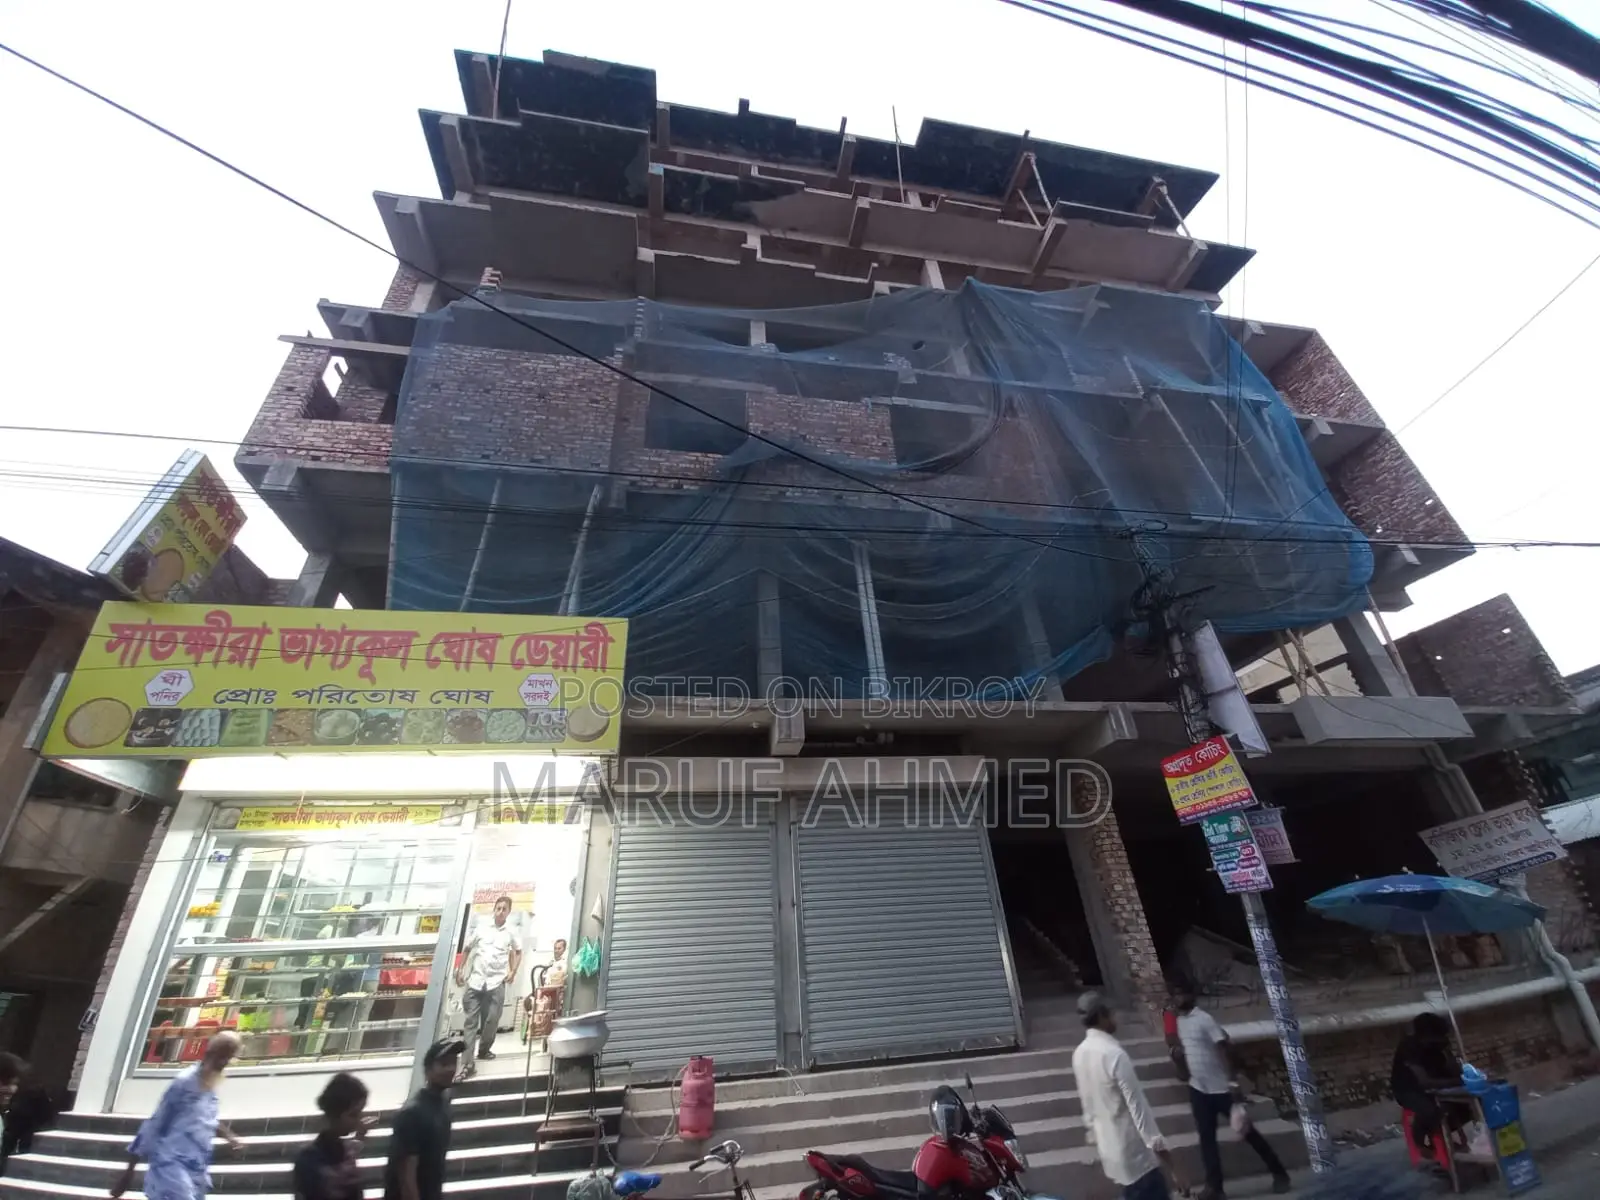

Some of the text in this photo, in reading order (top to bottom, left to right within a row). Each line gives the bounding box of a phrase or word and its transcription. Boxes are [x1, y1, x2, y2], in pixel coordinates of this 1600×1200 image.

[105, 609, 272, 670] সাতক্ষীরা
[426, 627, 504, 672] ঘোষ
[510, 621, 615, 674] ডেয়ারী
[161, 672, 187, 686] ঘী
[527, 678, 553, 689] মাখন
[150, 688, 182, 702] পনির
[291, 683, 416, 705] পরিতোষ
[430, 687, 494, 706] ঘোষ
[1195, 741, 1226, 764] কোচিং
